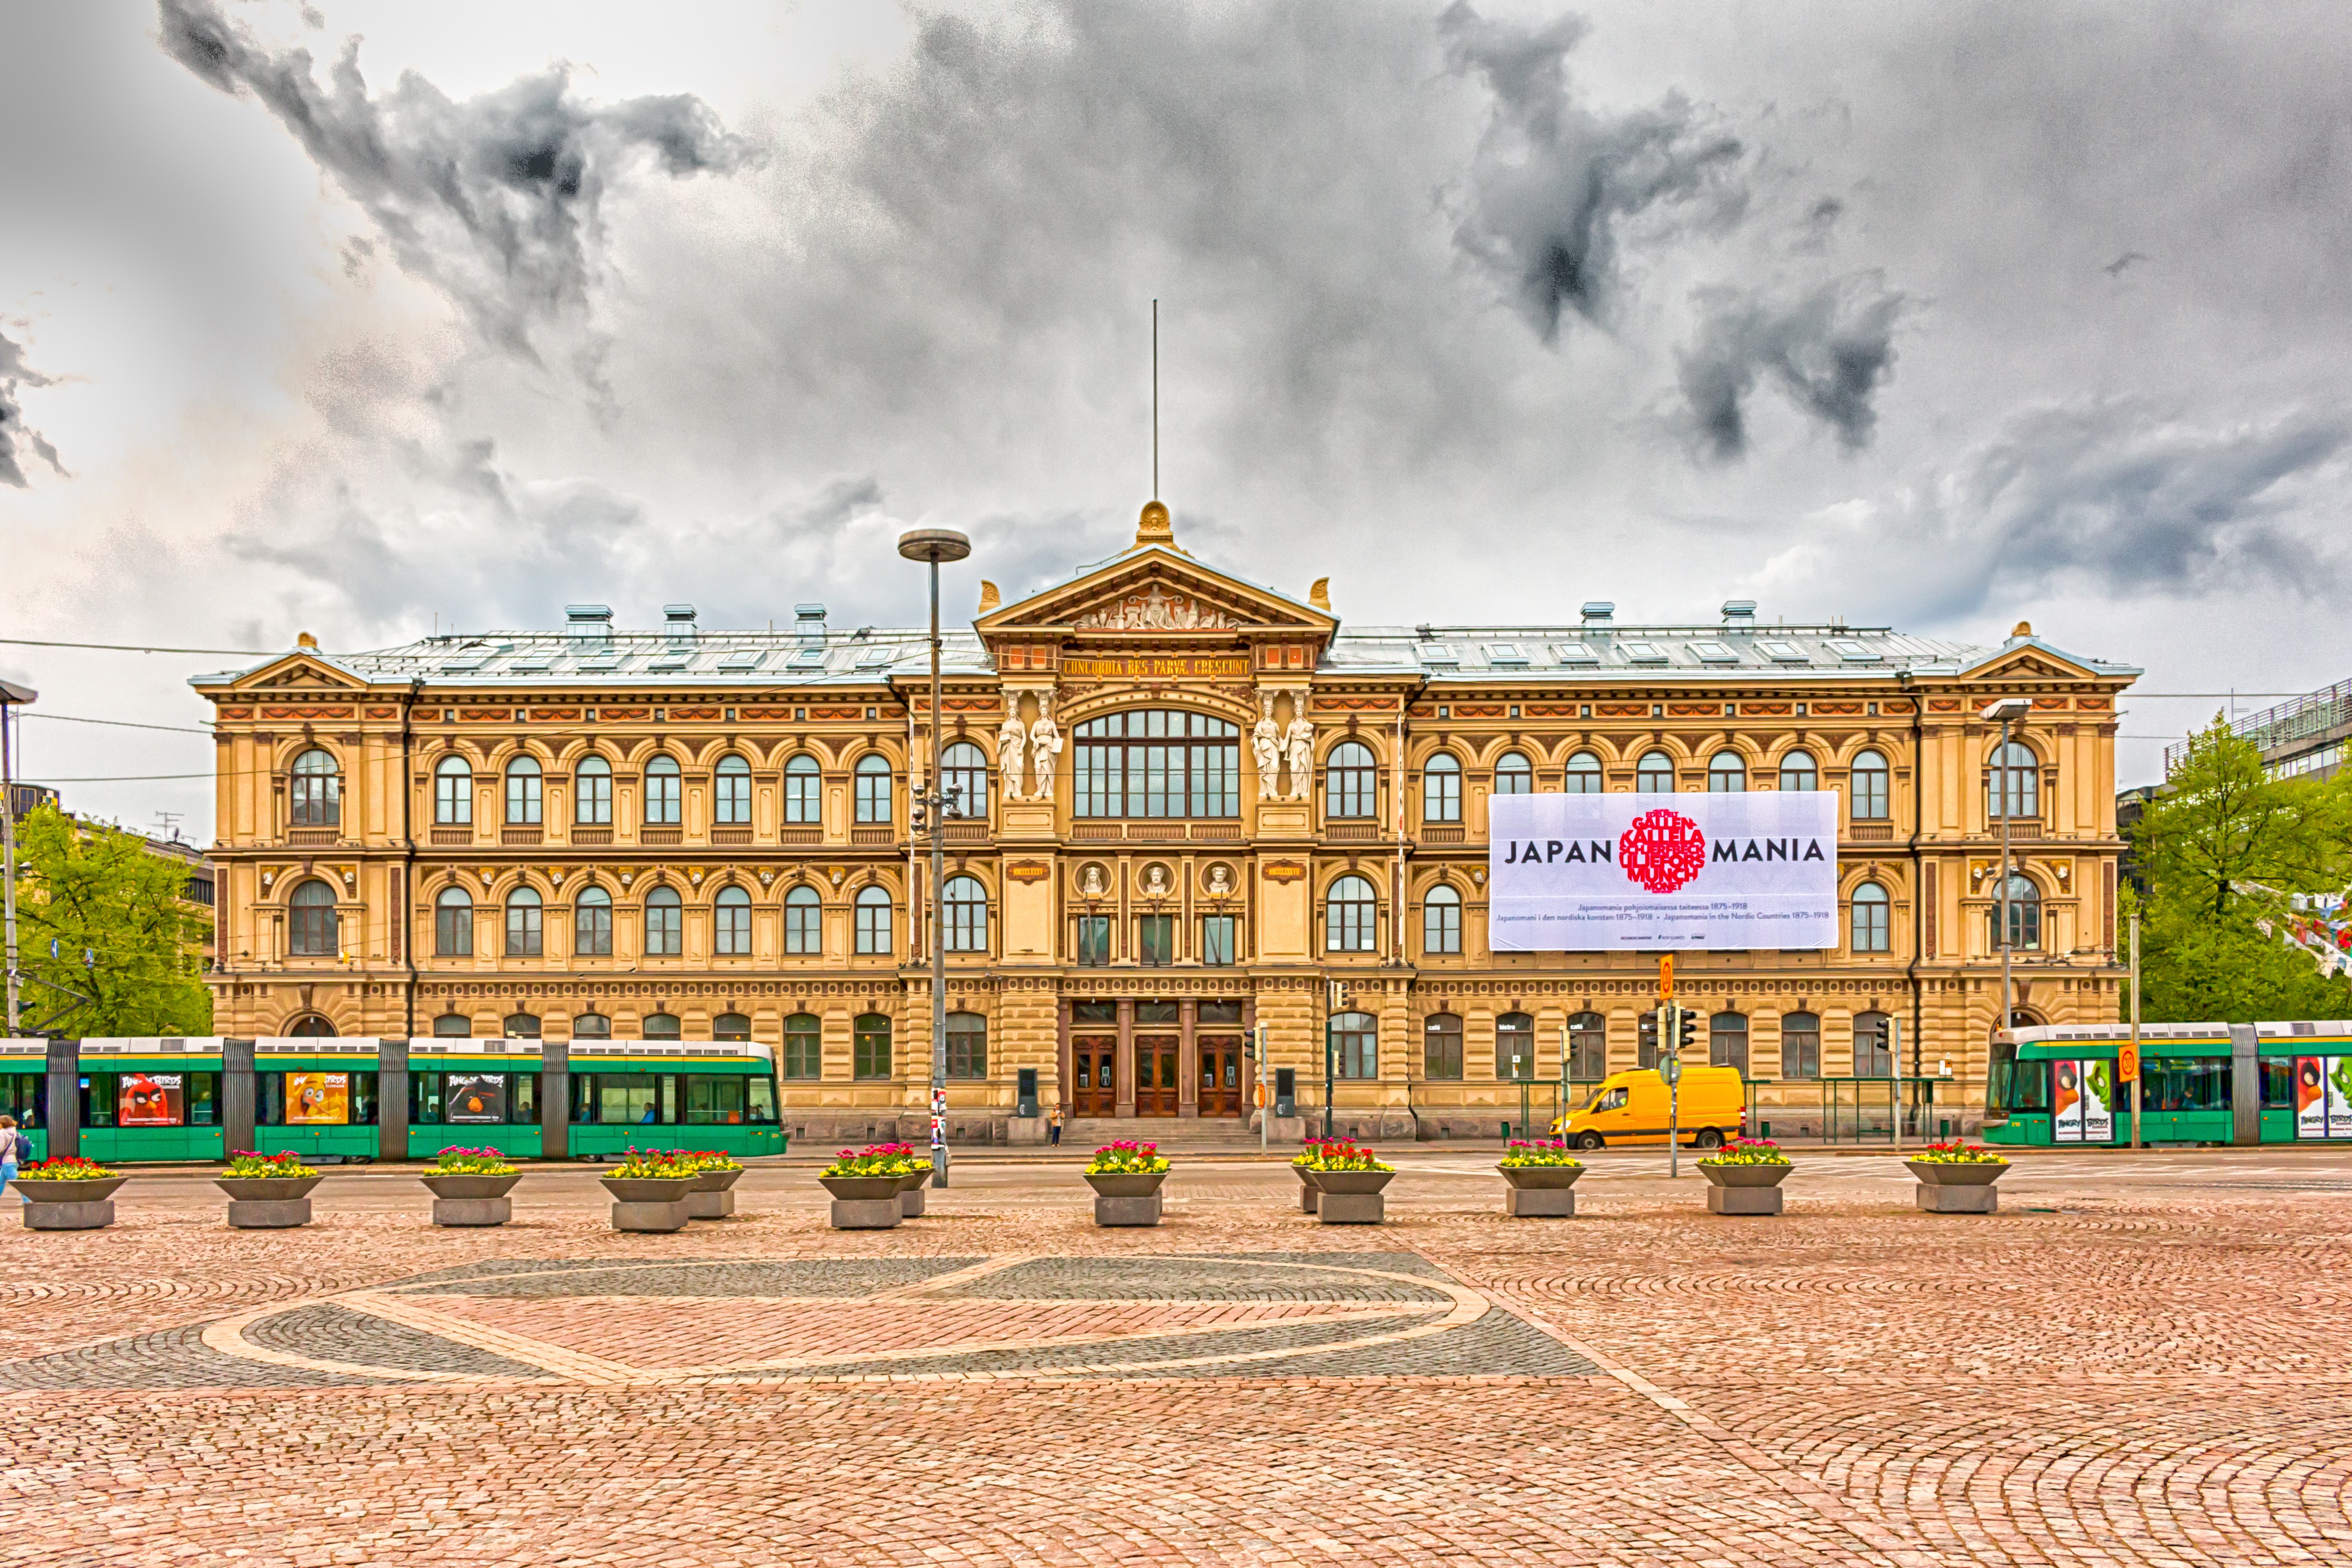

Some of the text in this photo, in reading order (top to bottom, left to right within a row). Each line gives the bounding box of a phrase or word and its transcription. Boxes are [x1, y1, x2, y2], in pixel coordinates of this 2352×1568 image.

[1065, 659, 1123, 675] CONCORDIA
[1127, 660, 1148, 675] RES
[1194, 659, 1250, 675] CRESCUNT
[1620, 829, 1705, 845] KALLELA
[1504, 838, 1825, 864] JAPAN MANIA
[1627, 867, 1698, 882] MUNCH
[1644, 882, 1683, 890] MONET
[1624, 903, 1677, 913] pohjoismaisessa
[1496, 914, 1537, 923] Japanomani
[1663, 913, 1708, 922] Japanomania
[2124, 1057, 2132, 1069] 30
[2058, 1119, 2080, 1129] ANGRY
[2086, 1118, 2109, 1127] BIRDS
[2300, 1115, 2324, 1125] ANGRY
